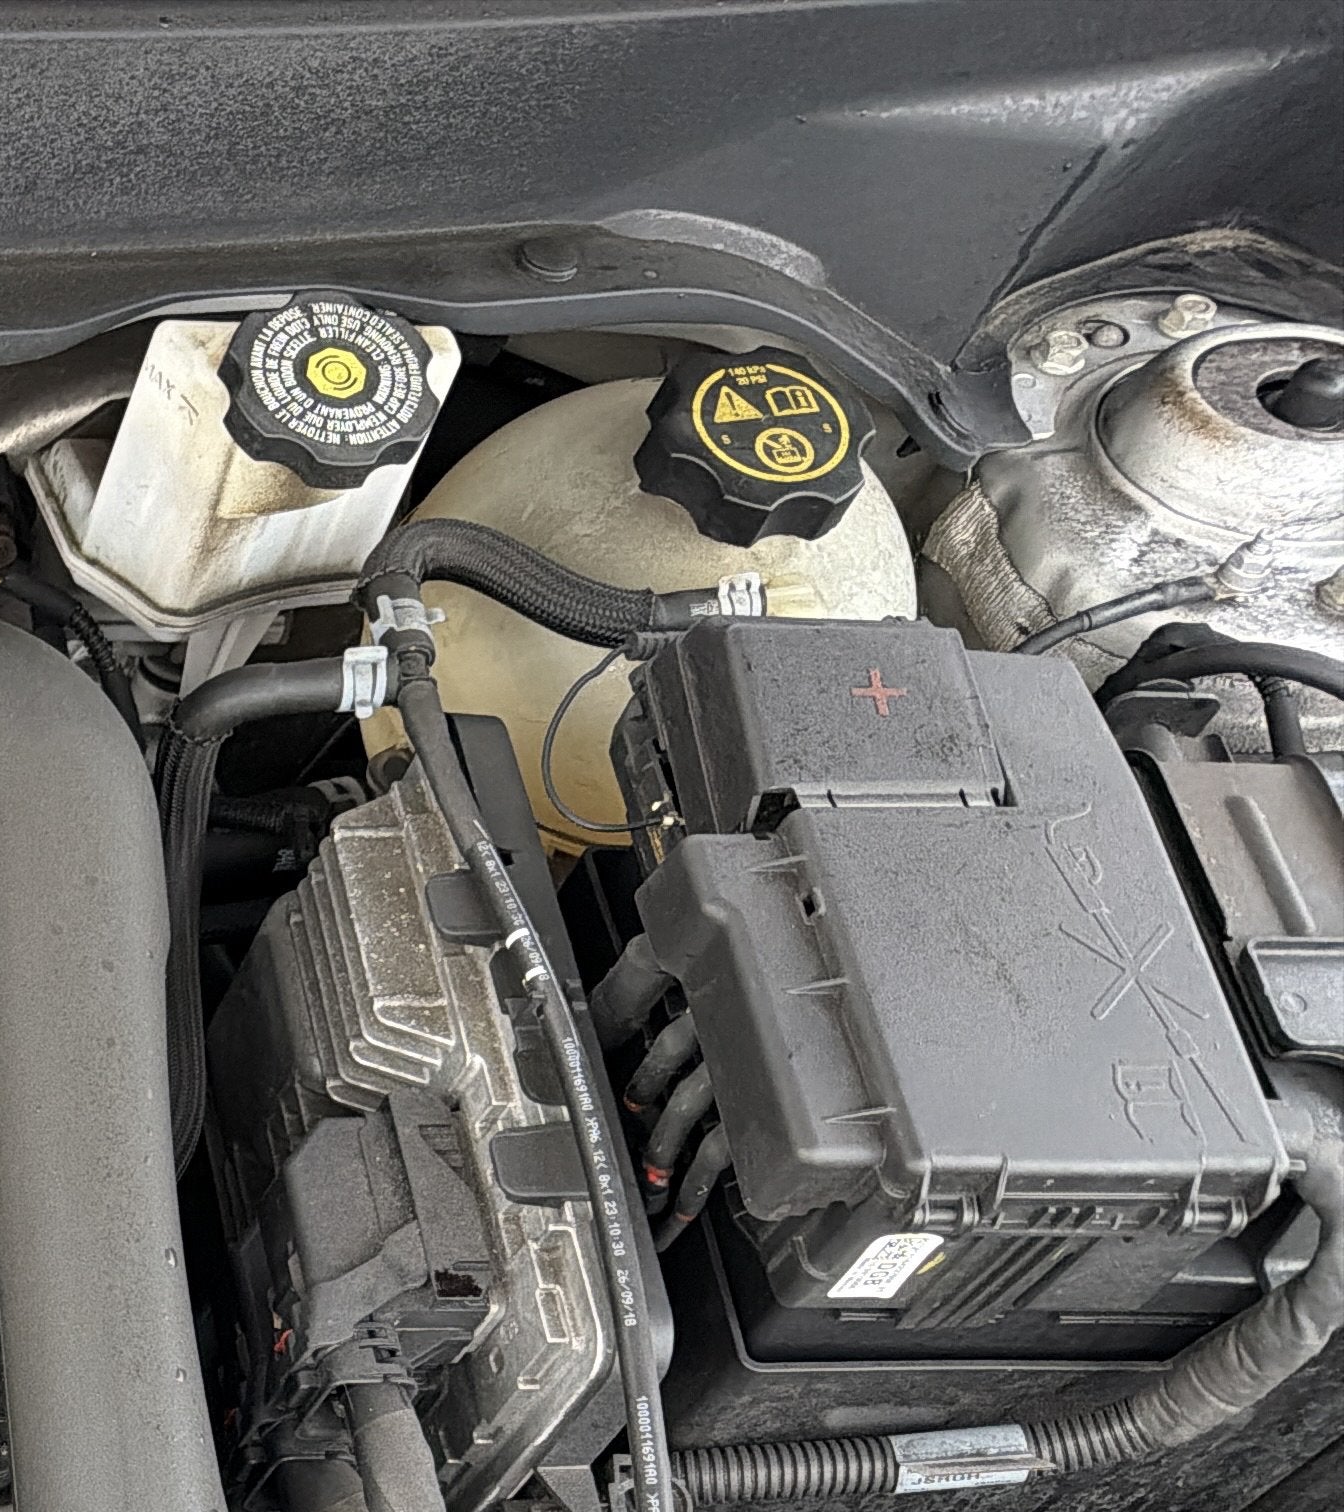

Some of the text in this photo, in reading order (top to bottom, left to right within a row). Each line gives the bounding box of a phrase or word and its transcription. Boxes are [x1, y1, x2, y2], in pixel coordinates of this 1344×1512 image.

[310, 314, 338, 326] ONLY
[340, 315, 362, 331] USE
[369, 314, 405, 344] SEALED
[257, 326, 274, 341] LA
[267, 330, 290, 356] FREIN
[317, 327, 356, 342] FILLER
[397, 341, 411, 350] A
[250, 338, 267, 367] AVANT
[353, 333, 385, 360] CLEAN
[265, 356, 278, 369] DE
[280, 358, 297, 387] BIDON
[402, 348, 422, 374] FROM
[250, 369, 280, 411] BOUCHON
[265, 371, 291, 404] LIQUIDE
[392, 366, 406, 399] BEFORE
[406, 375, 423, 402] FLUID
[736, 377, 750, 386] 20
[284, 401, 304, 416] DU
[287, 386, 315, 408] D'UN
[313, 400, 377, 418] PROVENANT
[383, 396, 402, 415] CAP
[273, 408, 291, 423] LE
[301, 411, 324, 428] QUE
[325, 410, 388, 431] N'EMPLOYER
[395, 399, 417, 423] DOT3
[286, 417, 339, 444] NETTOYER
[560, 1036, 593, 1111] 1000011691A0
[597, 1173, 614, 1194] 8x1
[603, 1199, 626, 1257] 23:10:30
[615, 1268, 638, 1327] 26/09/18
[634, 1395, 658, 1485] 1000011691A0
